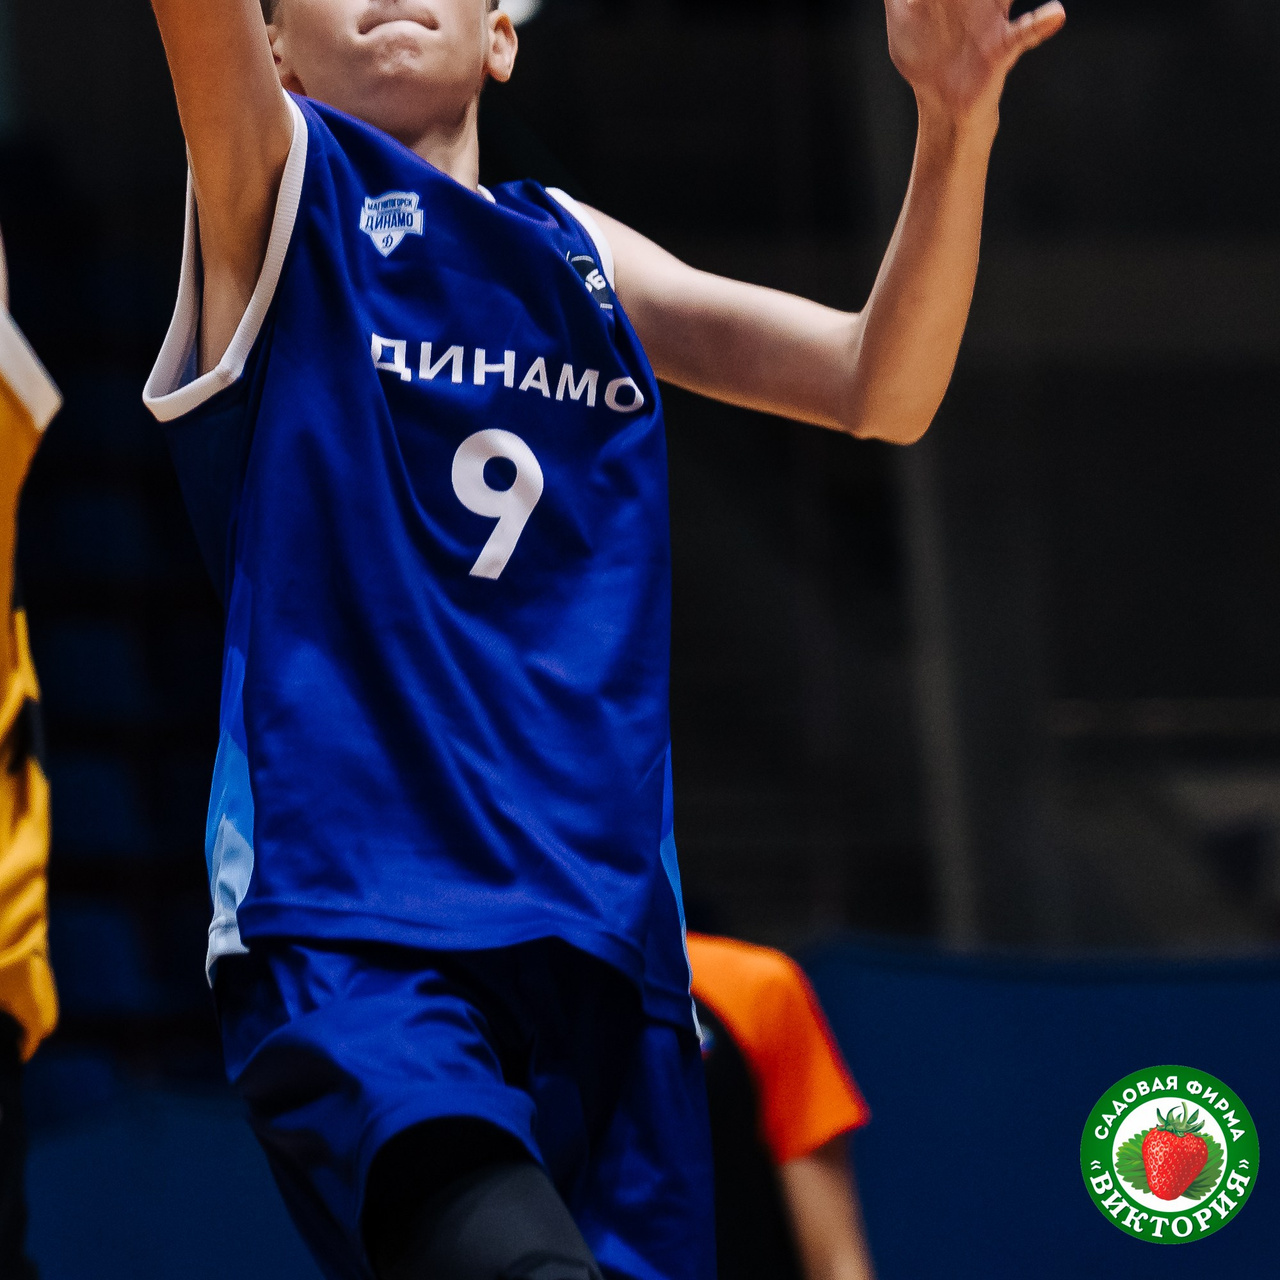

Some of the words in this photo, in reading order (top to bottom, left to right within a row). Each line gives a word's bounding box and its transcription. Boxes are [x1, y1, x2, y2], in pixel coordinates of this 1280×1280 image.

[365, 213, 414, 231] ДИНАМО
[371, 332, 645, 413] ДИНАМО
[451, 428, 544, 580] 9
